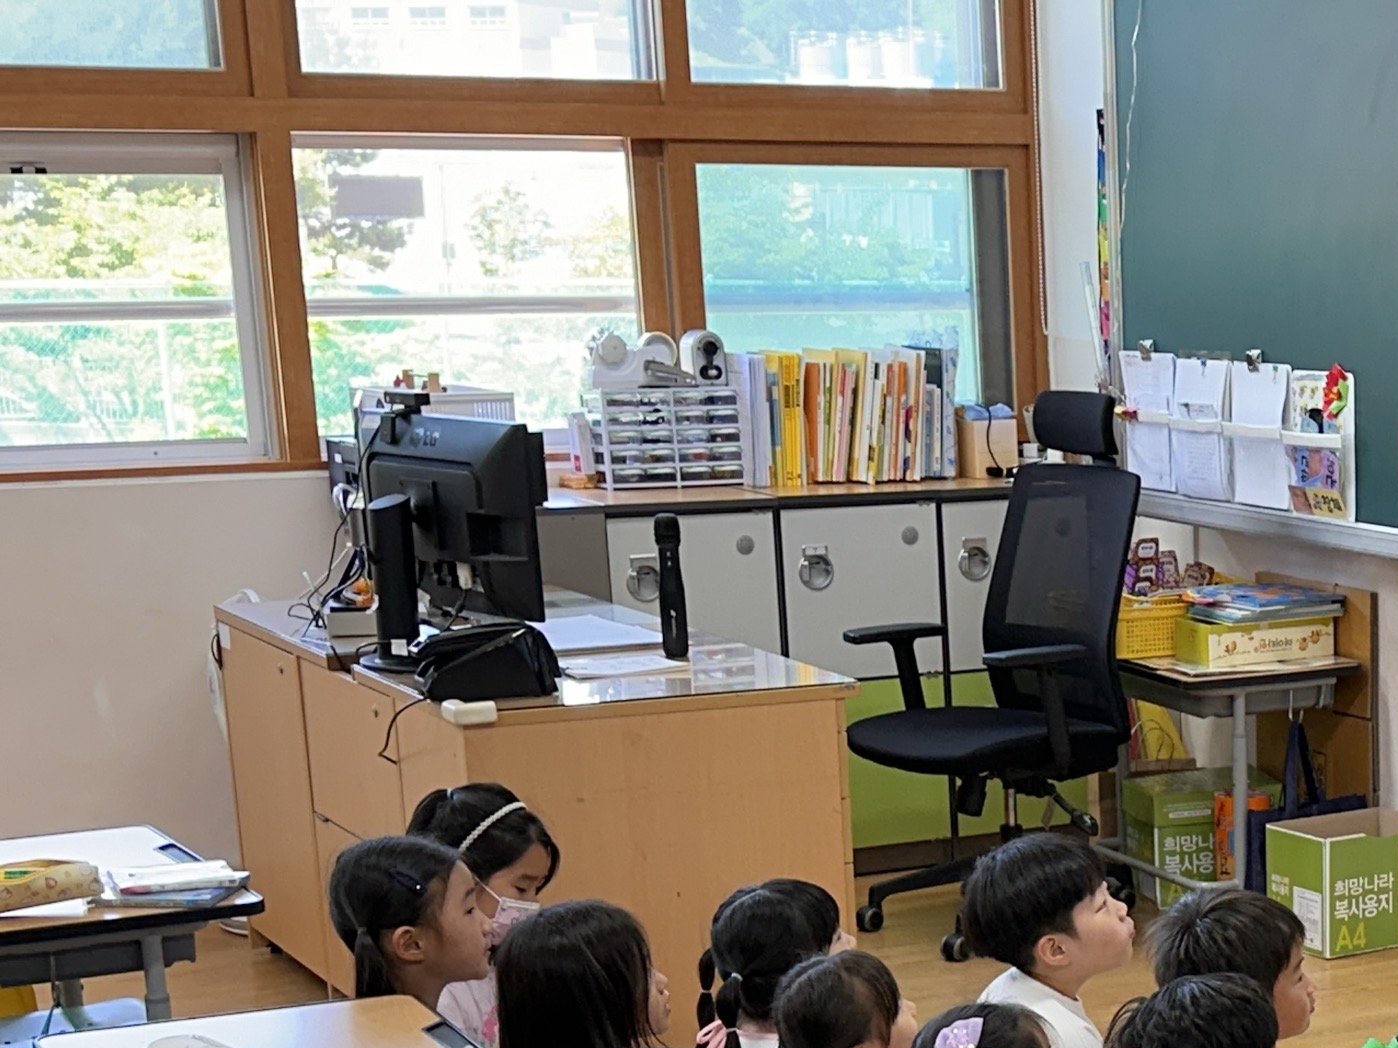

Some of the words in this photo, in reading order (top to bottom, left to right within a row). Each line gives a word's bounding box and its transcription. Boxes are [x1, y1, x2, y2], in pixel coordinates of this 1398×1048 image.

[423, 431, 439, 447] LG
[1334, 872, 1395, 897] 희망나라
[1333, 891, 1393, 922] 복사용지
[1335, 922, 1367, 951] A4
